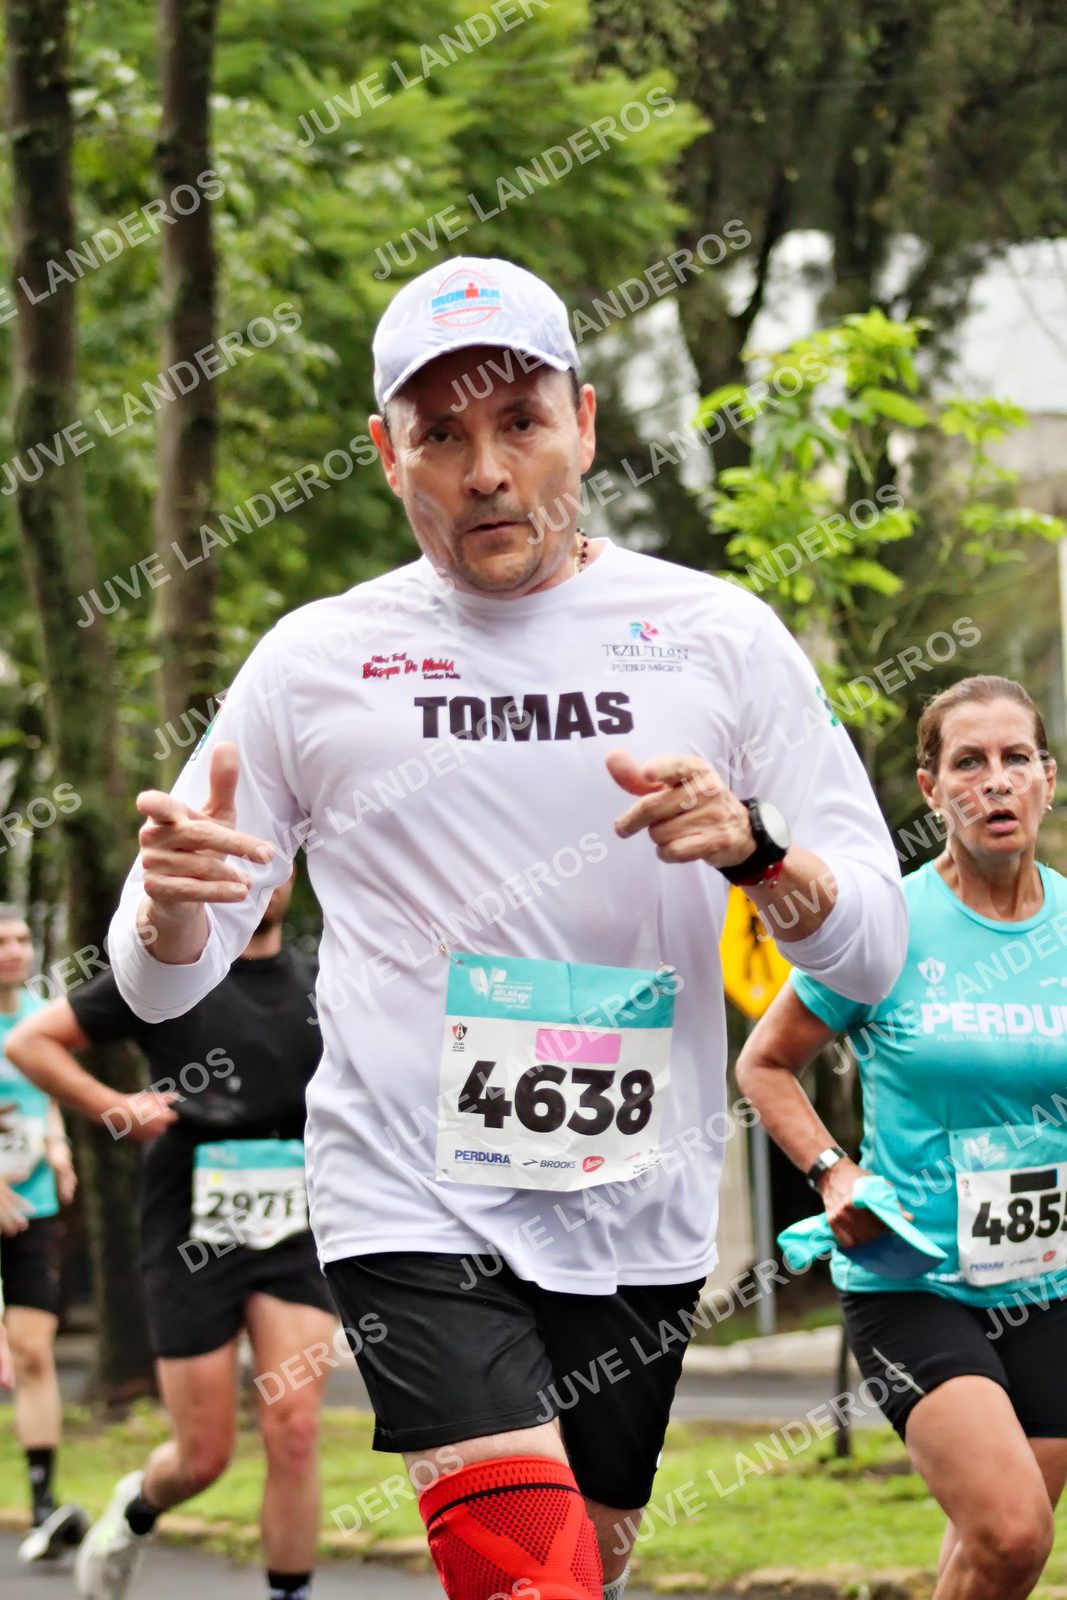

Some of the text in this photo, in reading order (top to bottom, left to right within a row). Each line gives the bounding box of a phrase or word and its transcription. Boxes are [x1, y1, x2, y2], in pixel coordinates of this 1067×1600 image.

[414, 691, 634, 741] TOMAS
[921, 1002, 1067, 1036] PERDU
[458, 1060, 655, 1136] 4638
[454, 1149, 511, 1164] PERDURA
[539, 1159, 576, 1169] BROOKS
